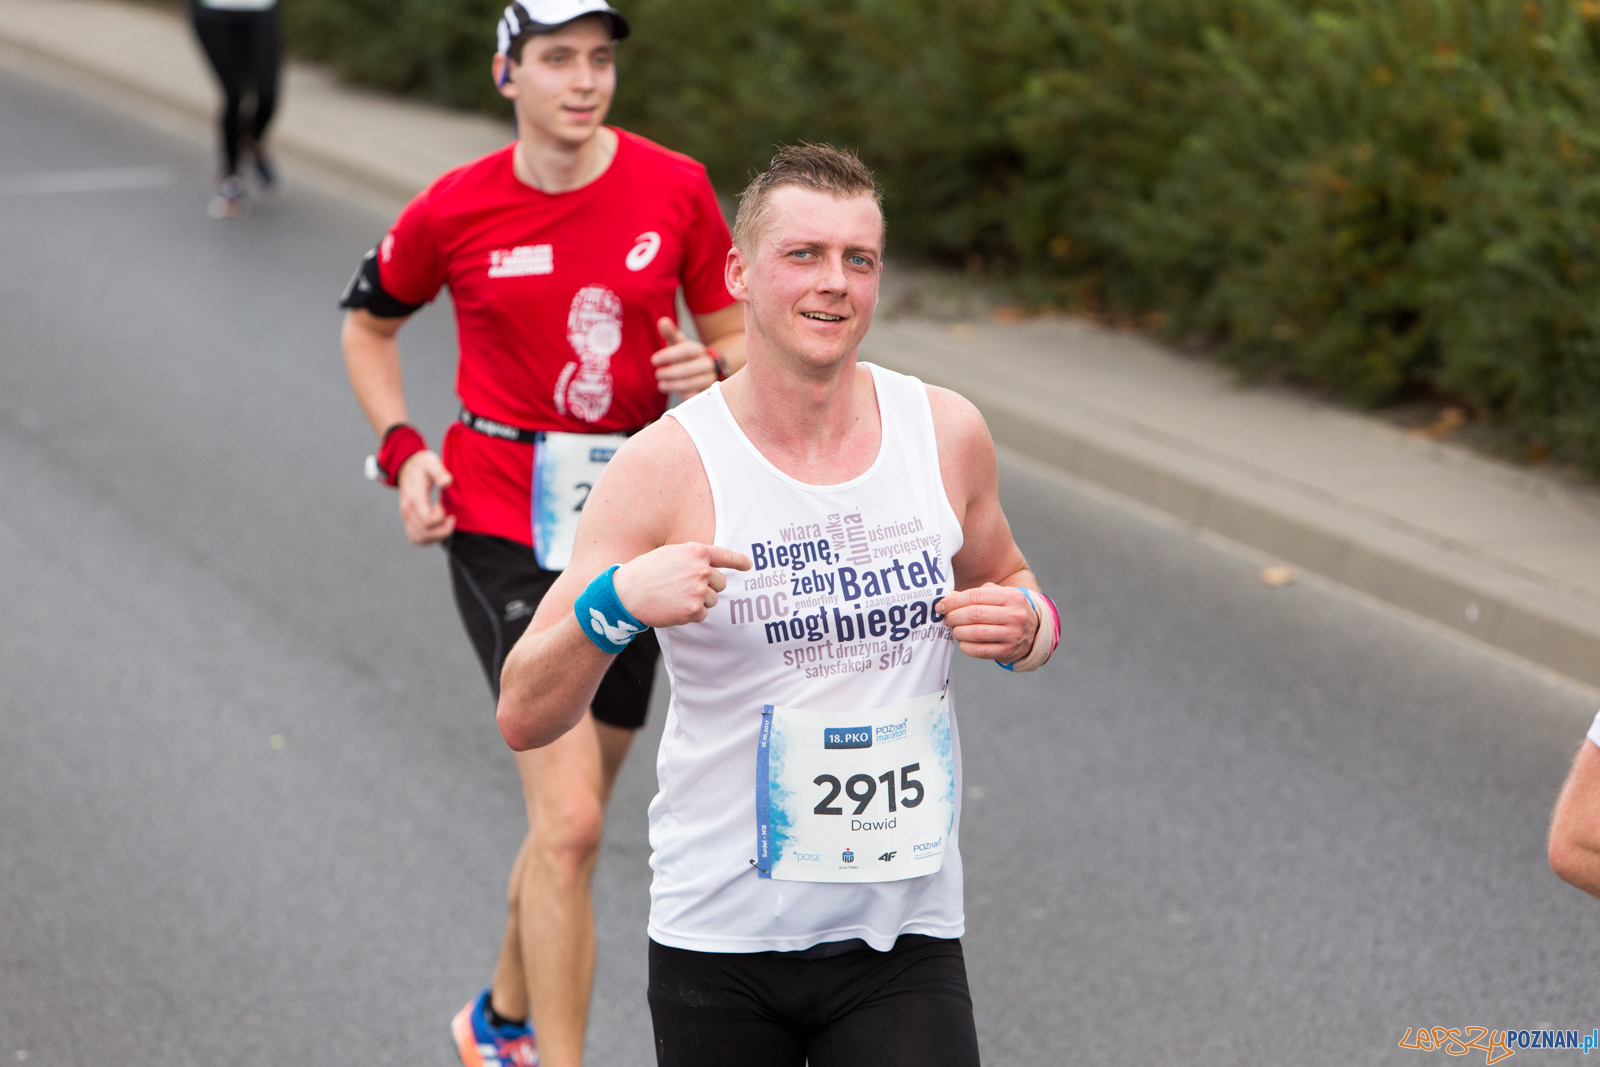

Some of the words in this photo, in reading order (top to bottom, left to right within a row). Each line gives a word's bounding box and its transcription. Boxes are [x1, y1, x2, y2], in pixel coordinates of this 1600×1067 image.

[779, 522, 821, 543] wiara
[826, 512, 847, 551] walka
[843, 512, 873, 566] duma
[868, 516, 924, 542] uśmiech
[751, 539, 840, 572] Biegnę,
[744, 569, 787, 592] radość
[790, 569, 836, 596] żeby
[838, 550, 945, 602] Bartek
[729, 591, 790, 625] moc
[795, 593, 838, 610] endorfiny
[865, 588, 932, 609] zaangażowanie
[765, 606, 830, 644] mógł
[833, 588, 946, 643] biegać
[783, 640, 835, 669] sport
[836, 640, 888, 659] drużyna
[879, 643, 913, 671] siła
[805, 659, 872, 679] satysfakcja
[828, 734, 844, 744] 18.
[845, 732, 869, 743] PKO
[876, 728, 907, 742] maraton
[812, 762, 925, 815] 2915
[851, 817, 897, 831] Dawid
